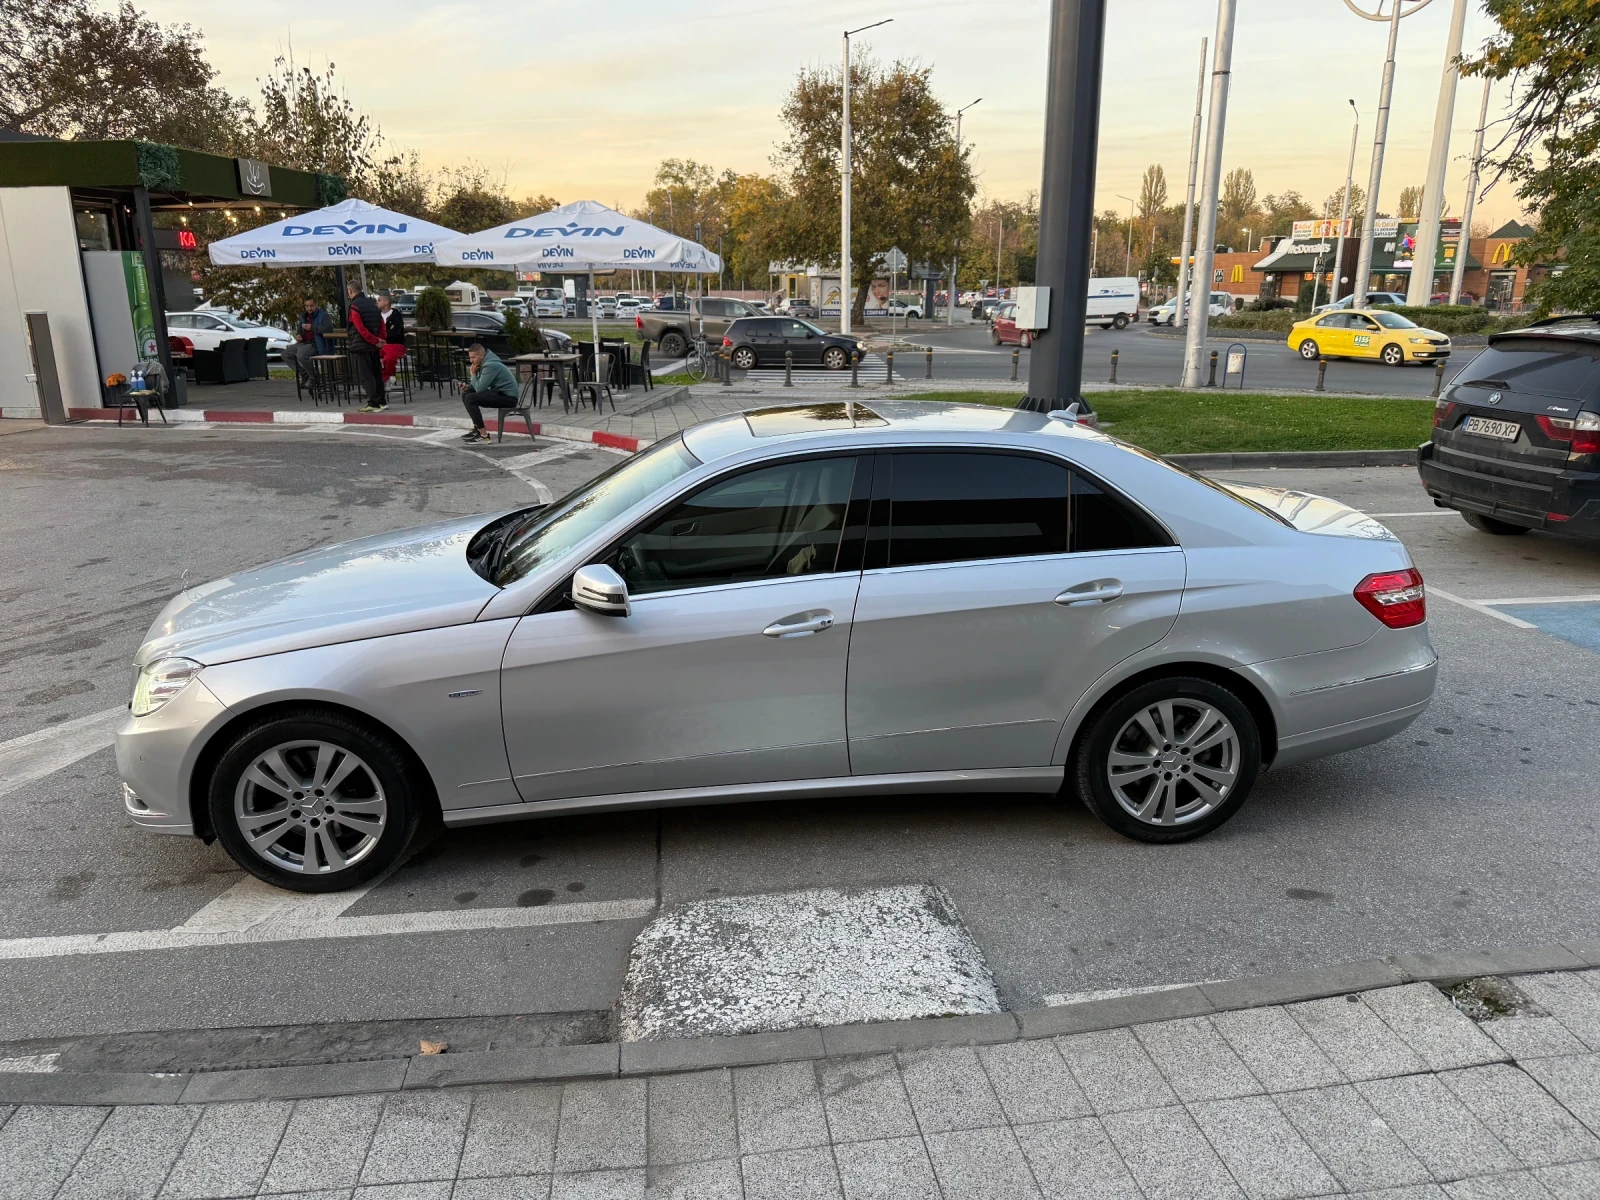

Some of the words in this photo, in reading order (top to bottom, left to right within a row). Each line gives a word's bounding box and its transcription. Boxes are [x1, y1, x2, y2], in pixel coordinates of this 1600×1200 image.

[281, 219, 407, 236] DEVIN
[504, 222, 625, 238] DEVIN
[240, 247, 276, 259] DEVIN
[328, 243, 362, 256] DEVIN
[462, 248, 494, 261] DEVIN
[542, 245, 574, 258] DEVIN
[623, 246, 656, 259] DEVIN
[1468, 418, 1480, 431] PB
[1479, 420, 1502, 434] 7690
[1502, 425, 1517, 437] XP
